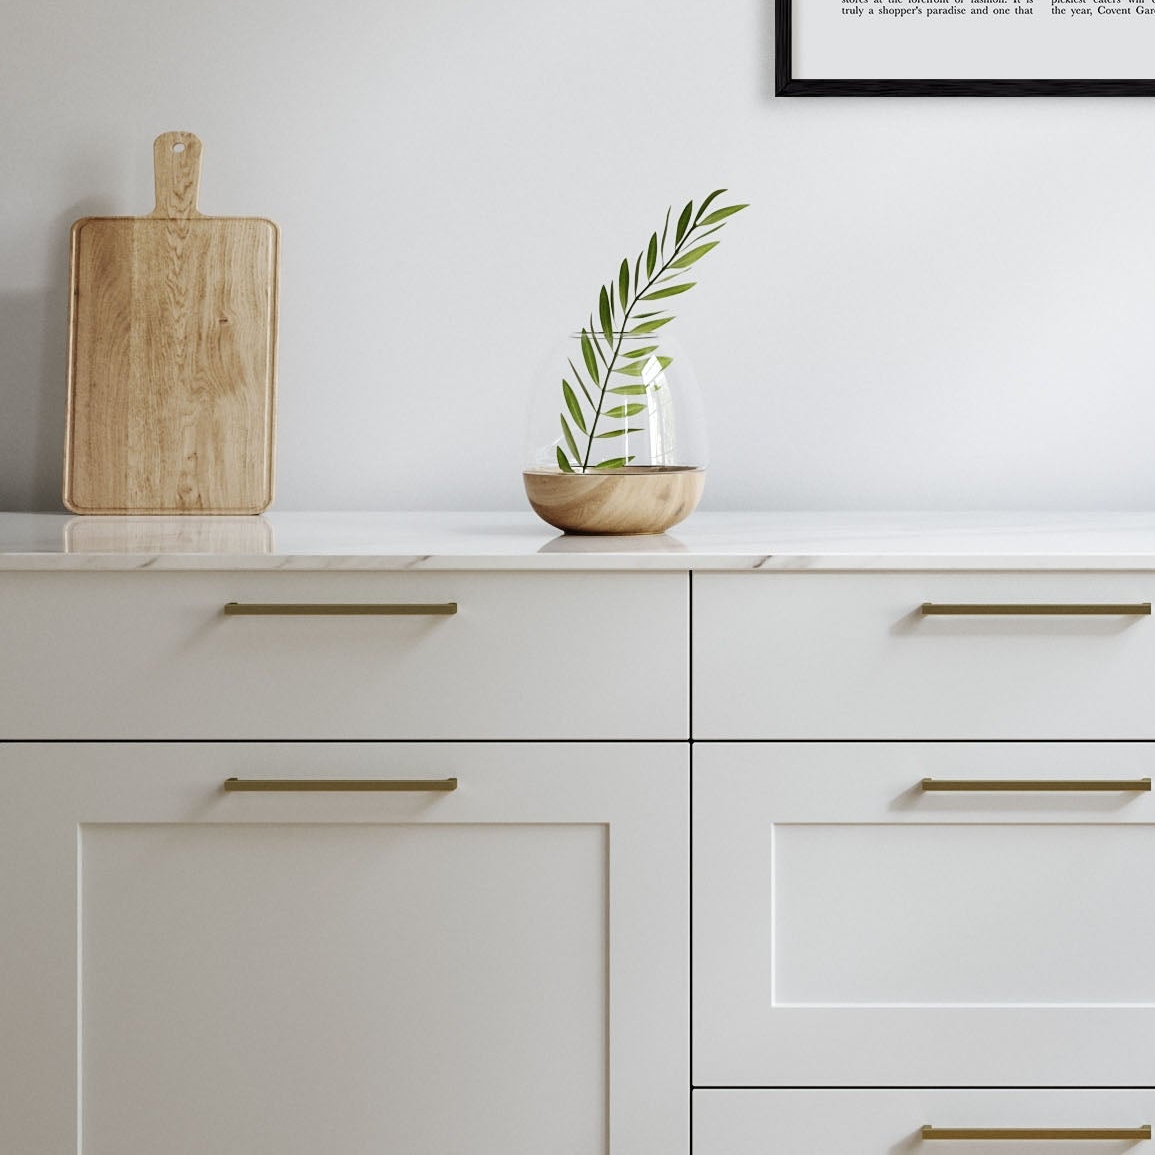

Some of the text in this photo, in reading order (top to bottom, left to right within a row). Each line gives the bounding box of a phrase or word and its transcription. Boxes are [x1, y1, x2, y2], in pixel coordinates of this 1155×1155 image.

[842, 6, 864, 17] truly
[878, 6, 922, 17] shopper's
[927, 6, 966, 17] paradise
[970, 6, 988, 14] and
[1015, 6, 1033, 14] that
[1051, 6, 1066, 14] the
[1070, 8, 1093, 17] year,
[1097, 6, 1131, 14] Covent
